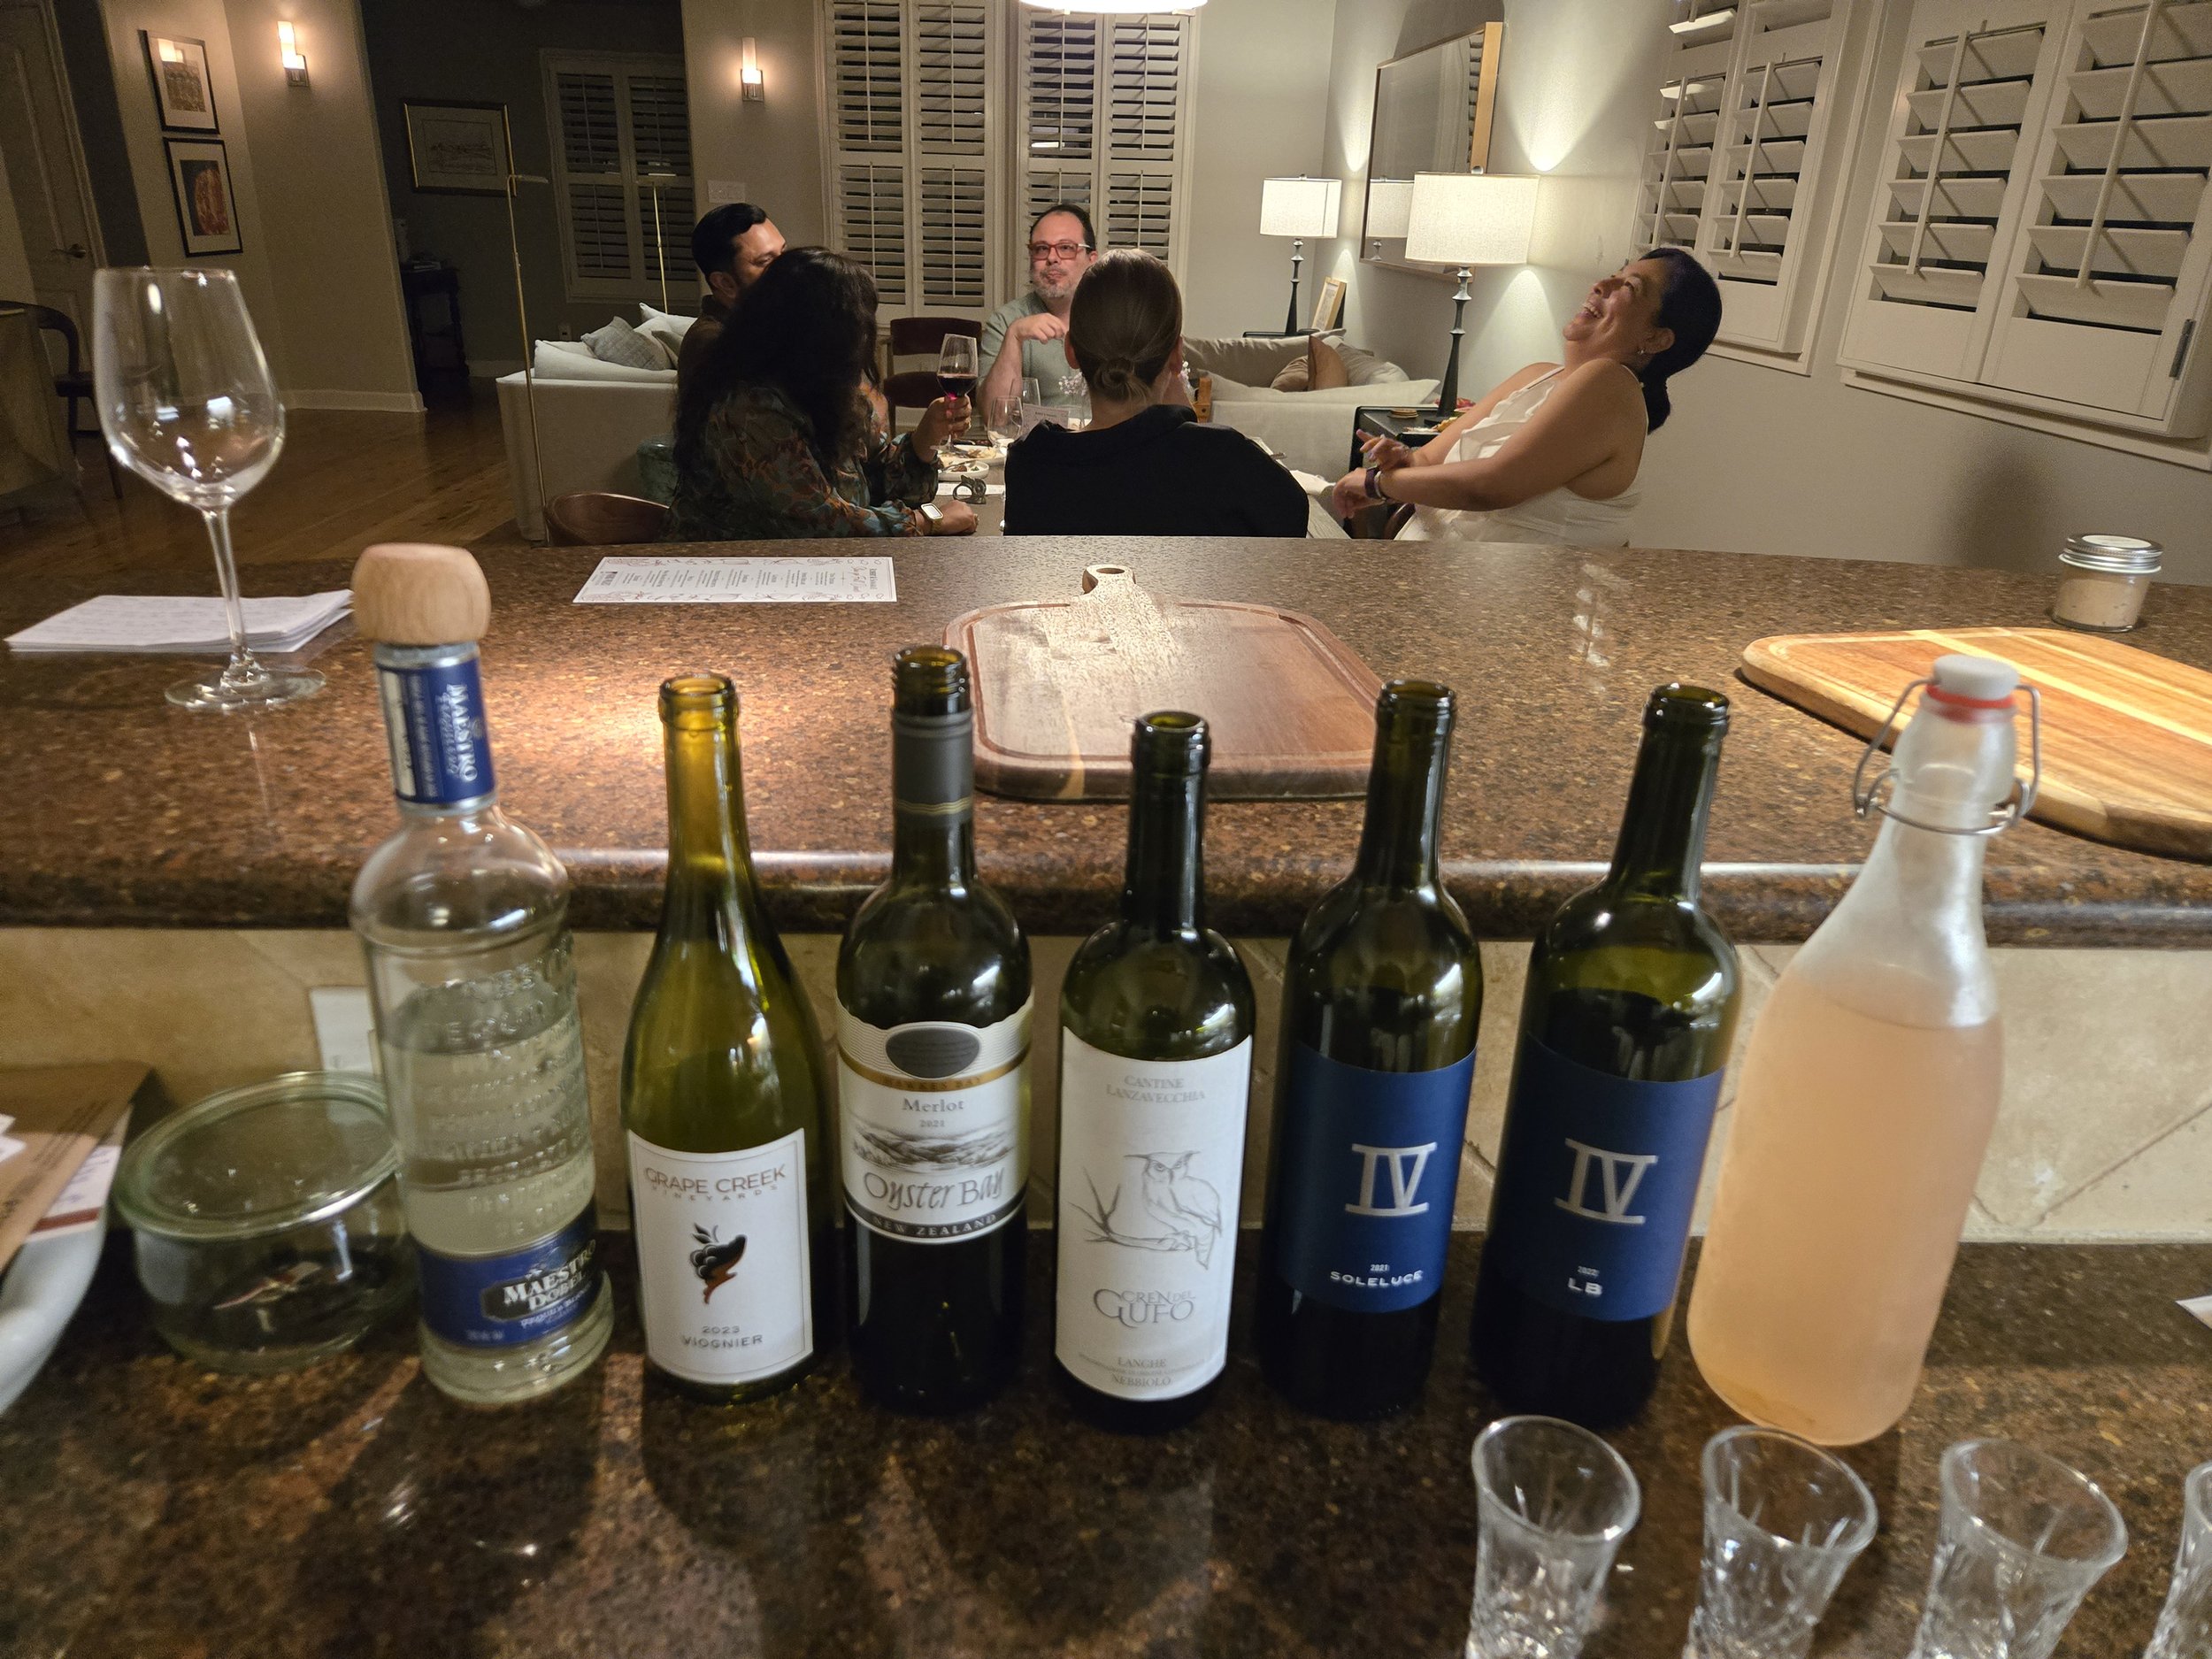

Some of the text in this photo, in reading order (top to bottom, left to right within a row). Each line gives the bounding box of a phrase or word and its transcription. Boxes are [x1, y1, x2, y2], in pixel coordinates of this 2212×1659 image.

[447, 684, 478, 782] MAESTRO
[1124, 1074, 1184, 1089] CANTINE
[1106, 1084, 1206, 1103] LANZAVECCHIA
[902, 1097, 964, 1113] Merlot
[645, 1164, 787, 1194] GRAPE CREEK
[864, 1167, 1006, 1210] Oyster Bay
[1345, 1141, 1438, 1217] IV
[1554, 1138, 1659, 1225] IV
[651, 1184, 779, 1202] VINEYARDS
[872, 1213, 997, 1236] NEW ZEALAND
[503, 1239, 596, 1307] MAESTRO
[1330, 1269, 1425, 1286] SOLELUCE
[1567, 1277, 1603, 1298] LB
[1093, 1288, 1194, 1328] GUFO
[682, 1333, 764, 1349] VIOGNIER
[1117, 1356, 1168, 1368] LANGHE
[1110, 1372, 1172, 1387] NEBBIOLO
